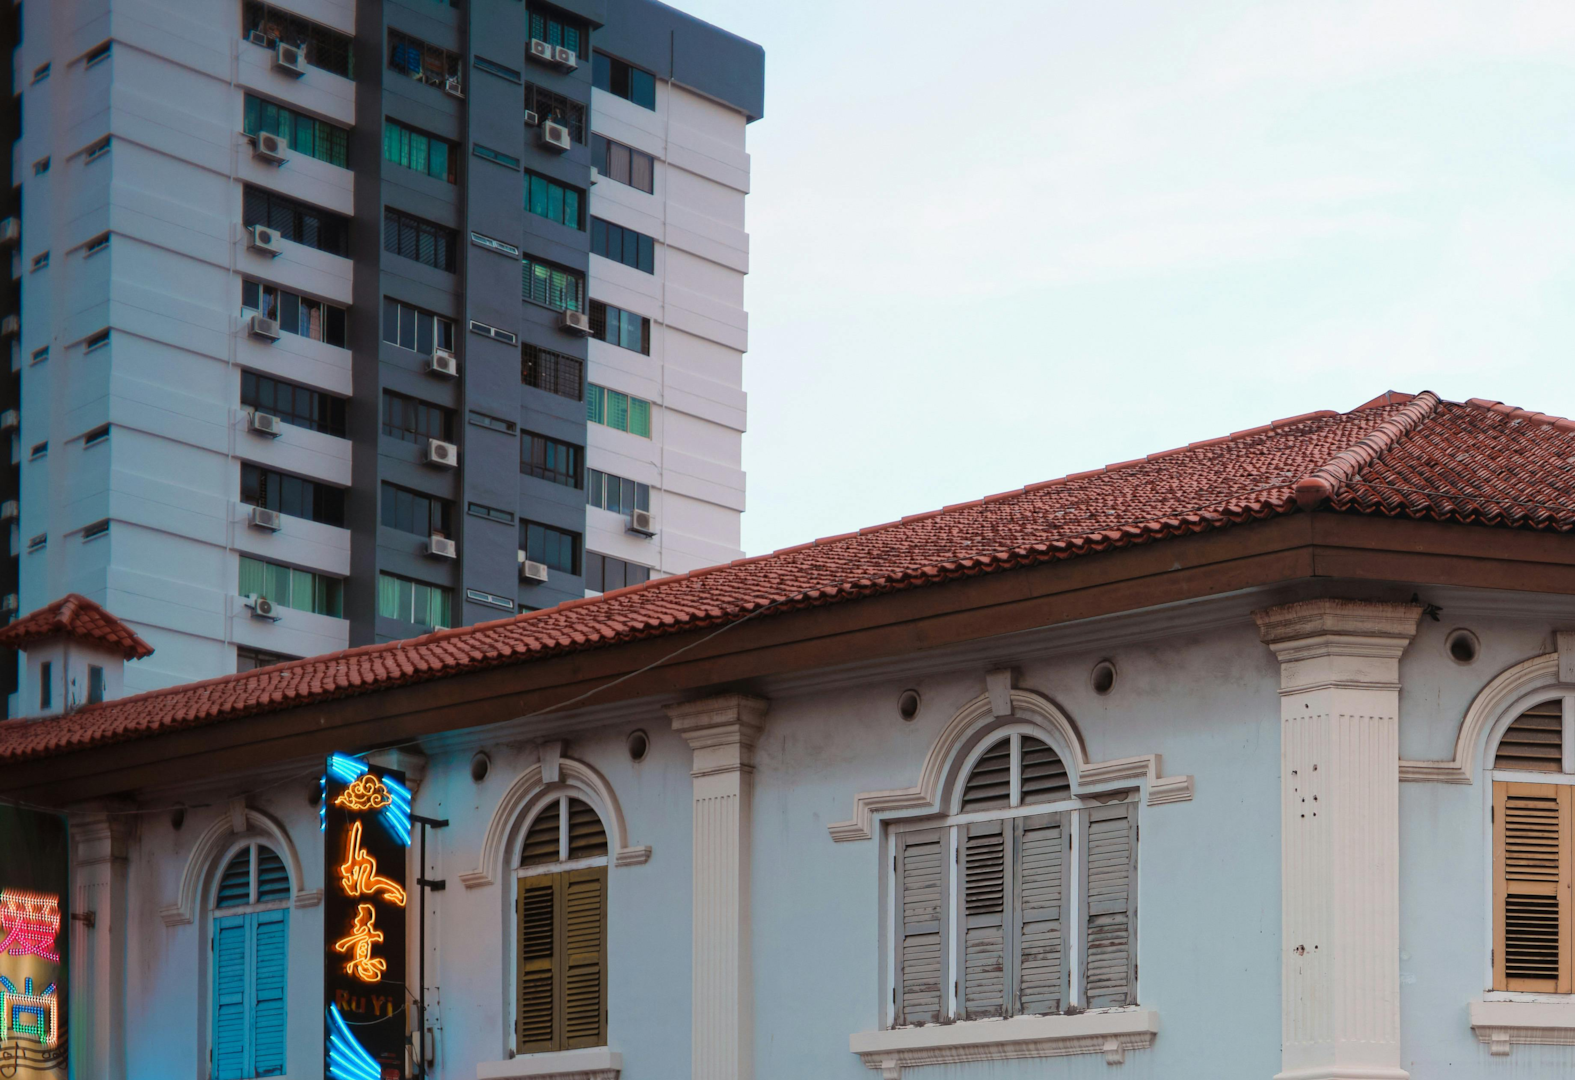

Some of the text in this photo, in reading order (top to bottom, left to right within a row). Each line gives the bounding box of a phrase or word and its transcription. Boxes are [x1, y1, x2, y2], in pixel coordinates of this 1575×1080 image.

[0, 887, 61, 1048] 爱尚
[336, 821, 407, 982] 如意
[334, 988, 393, 1018] Ru Yi
